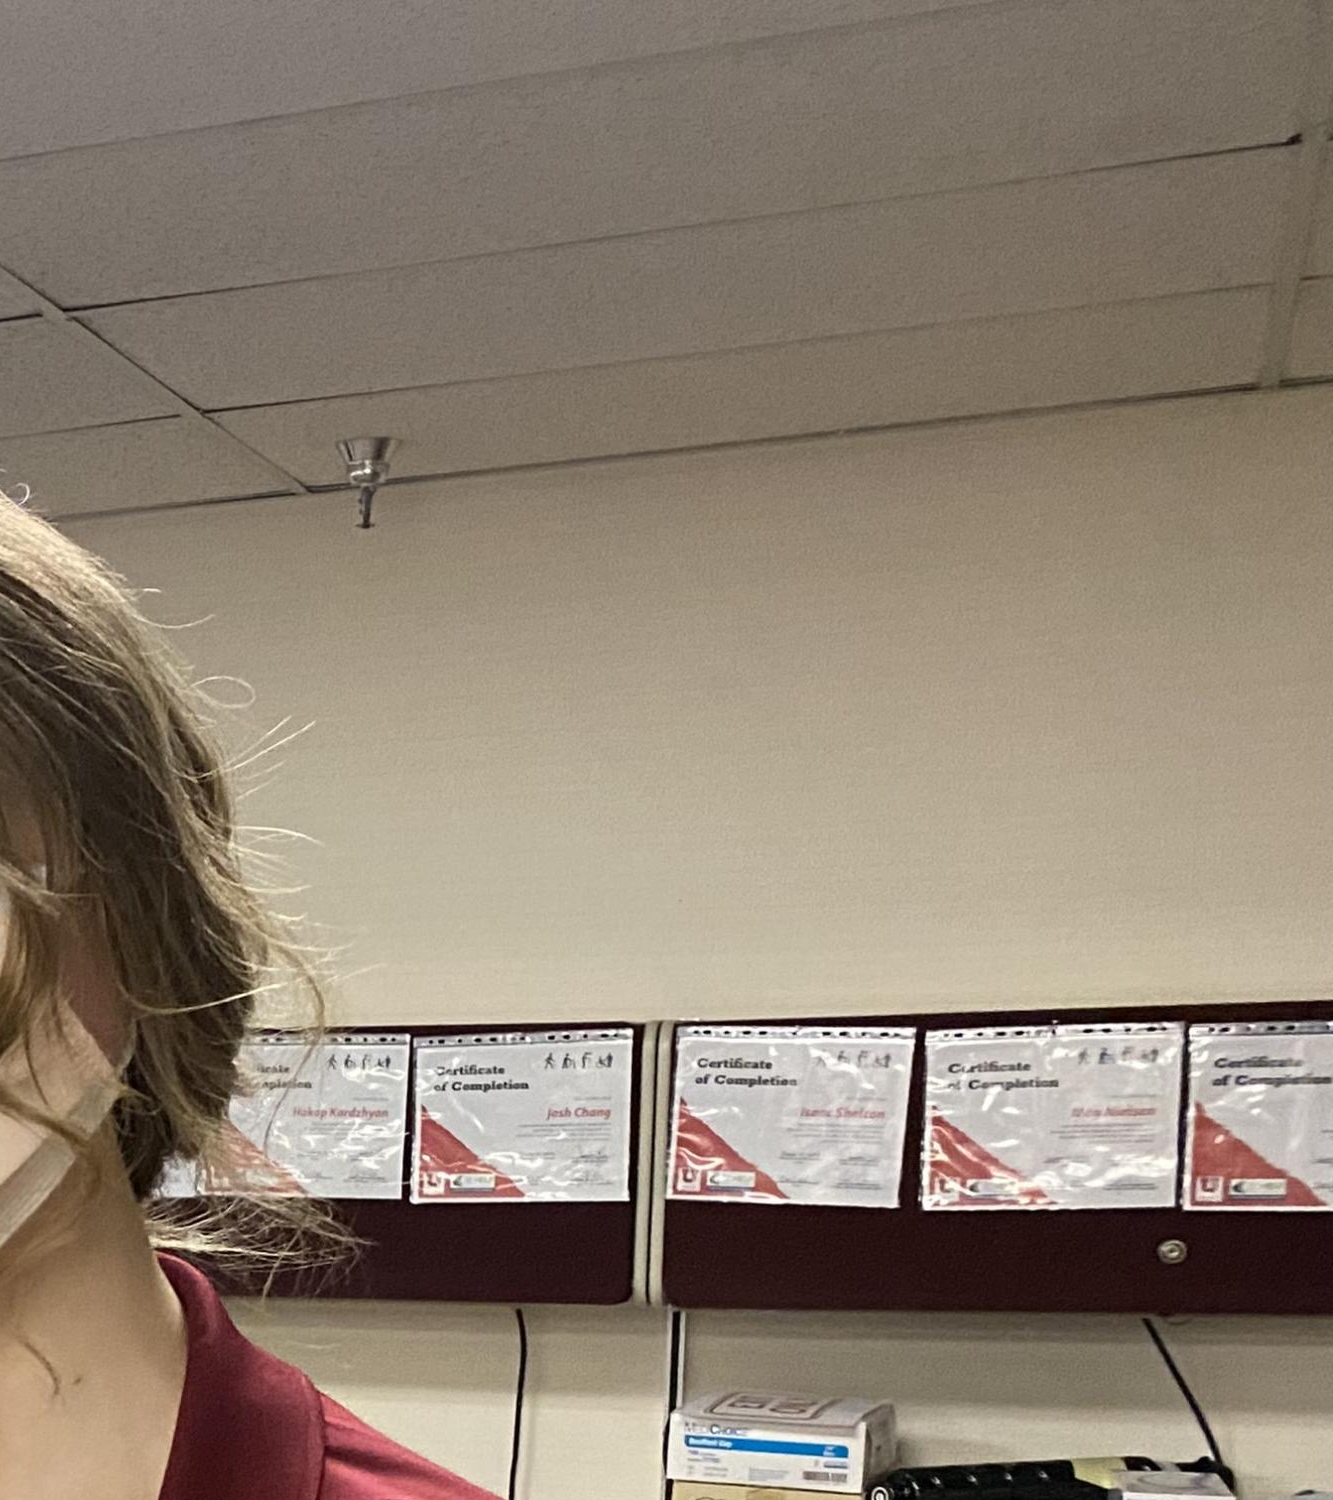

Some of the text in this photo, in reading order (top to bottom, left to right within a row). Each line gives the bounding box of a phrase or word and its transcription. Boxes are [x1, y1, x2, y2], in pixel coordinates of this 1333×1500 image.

[698, 1057, 773, 1070] Certificate
[1214, 1055, 1303, 1068] Certificate
[435, 1065, 506, 1076] Certificate
[434, 1079, 530, 1092] of Completion
[695, 1075, 798, 1087] of Completion
[1212, 1074, 1332, 1087] of Completion
[574, 1107, 612, 1120] Chang
